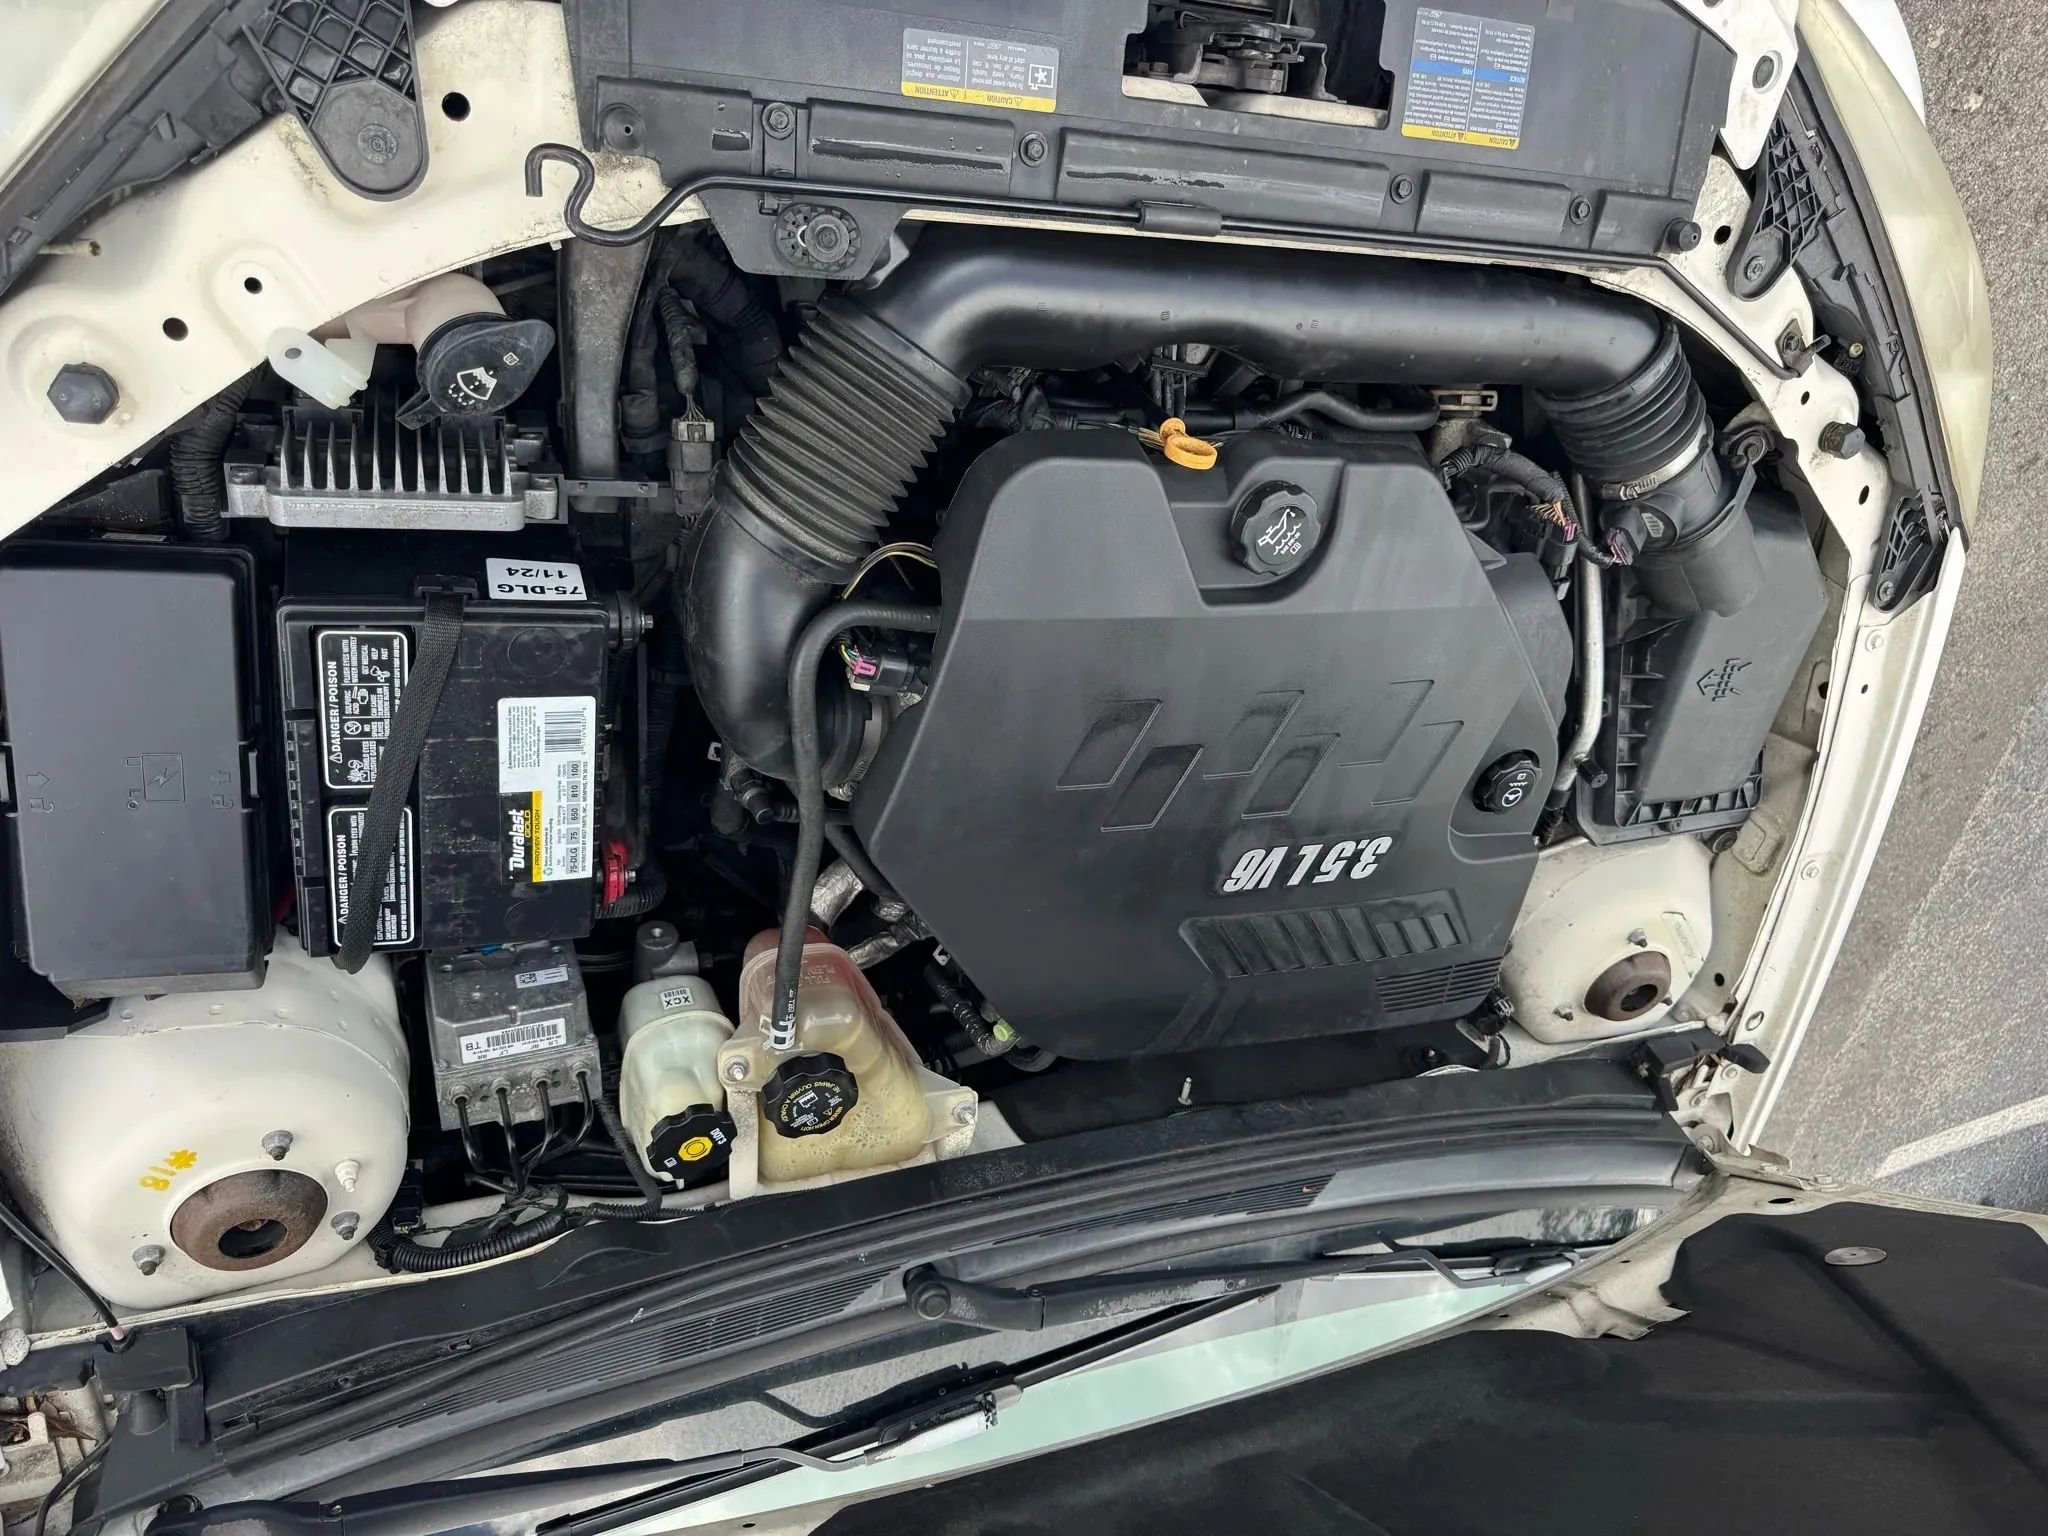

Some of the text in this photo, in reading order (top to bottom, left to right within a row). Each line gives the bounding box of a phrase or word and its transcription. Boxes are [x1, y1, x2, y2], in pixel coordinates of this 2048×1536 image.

[1509, 75, 1526, 83] NOTICE
[914, 86, 949, 96] ATTENTION
[986, 94, 1013, 105] CAUTION
[1431, 130, 1456, 138] ATTENTION
[506, 567, 568, 578] 11/24
[497, 584, 582, 595] 75-DLG
[350, 636, 359, 683] WATER IMMEDIATELY
[371, 648, 379, 660] HELP
[343, 667, 351, 683] FLUSH
[344, 690, 352, 714] SULFURIC
[364, 724, 370, 732] NO
[508, 809, 525, 871] Duralast
[571, 832, 578, 840] 75
[1311, 836, 1393, 884] 3.5
[1222, 846, 1289, 893] V6
[665, 996, 690, 1007] XCX
[465, 1041, 481, 1051] TB
[788, 1083, 812, 1099] OUVRIR
[830, 1106, 844, 1121] NEVER
[815, 1118, 830, 1129] OPEN
